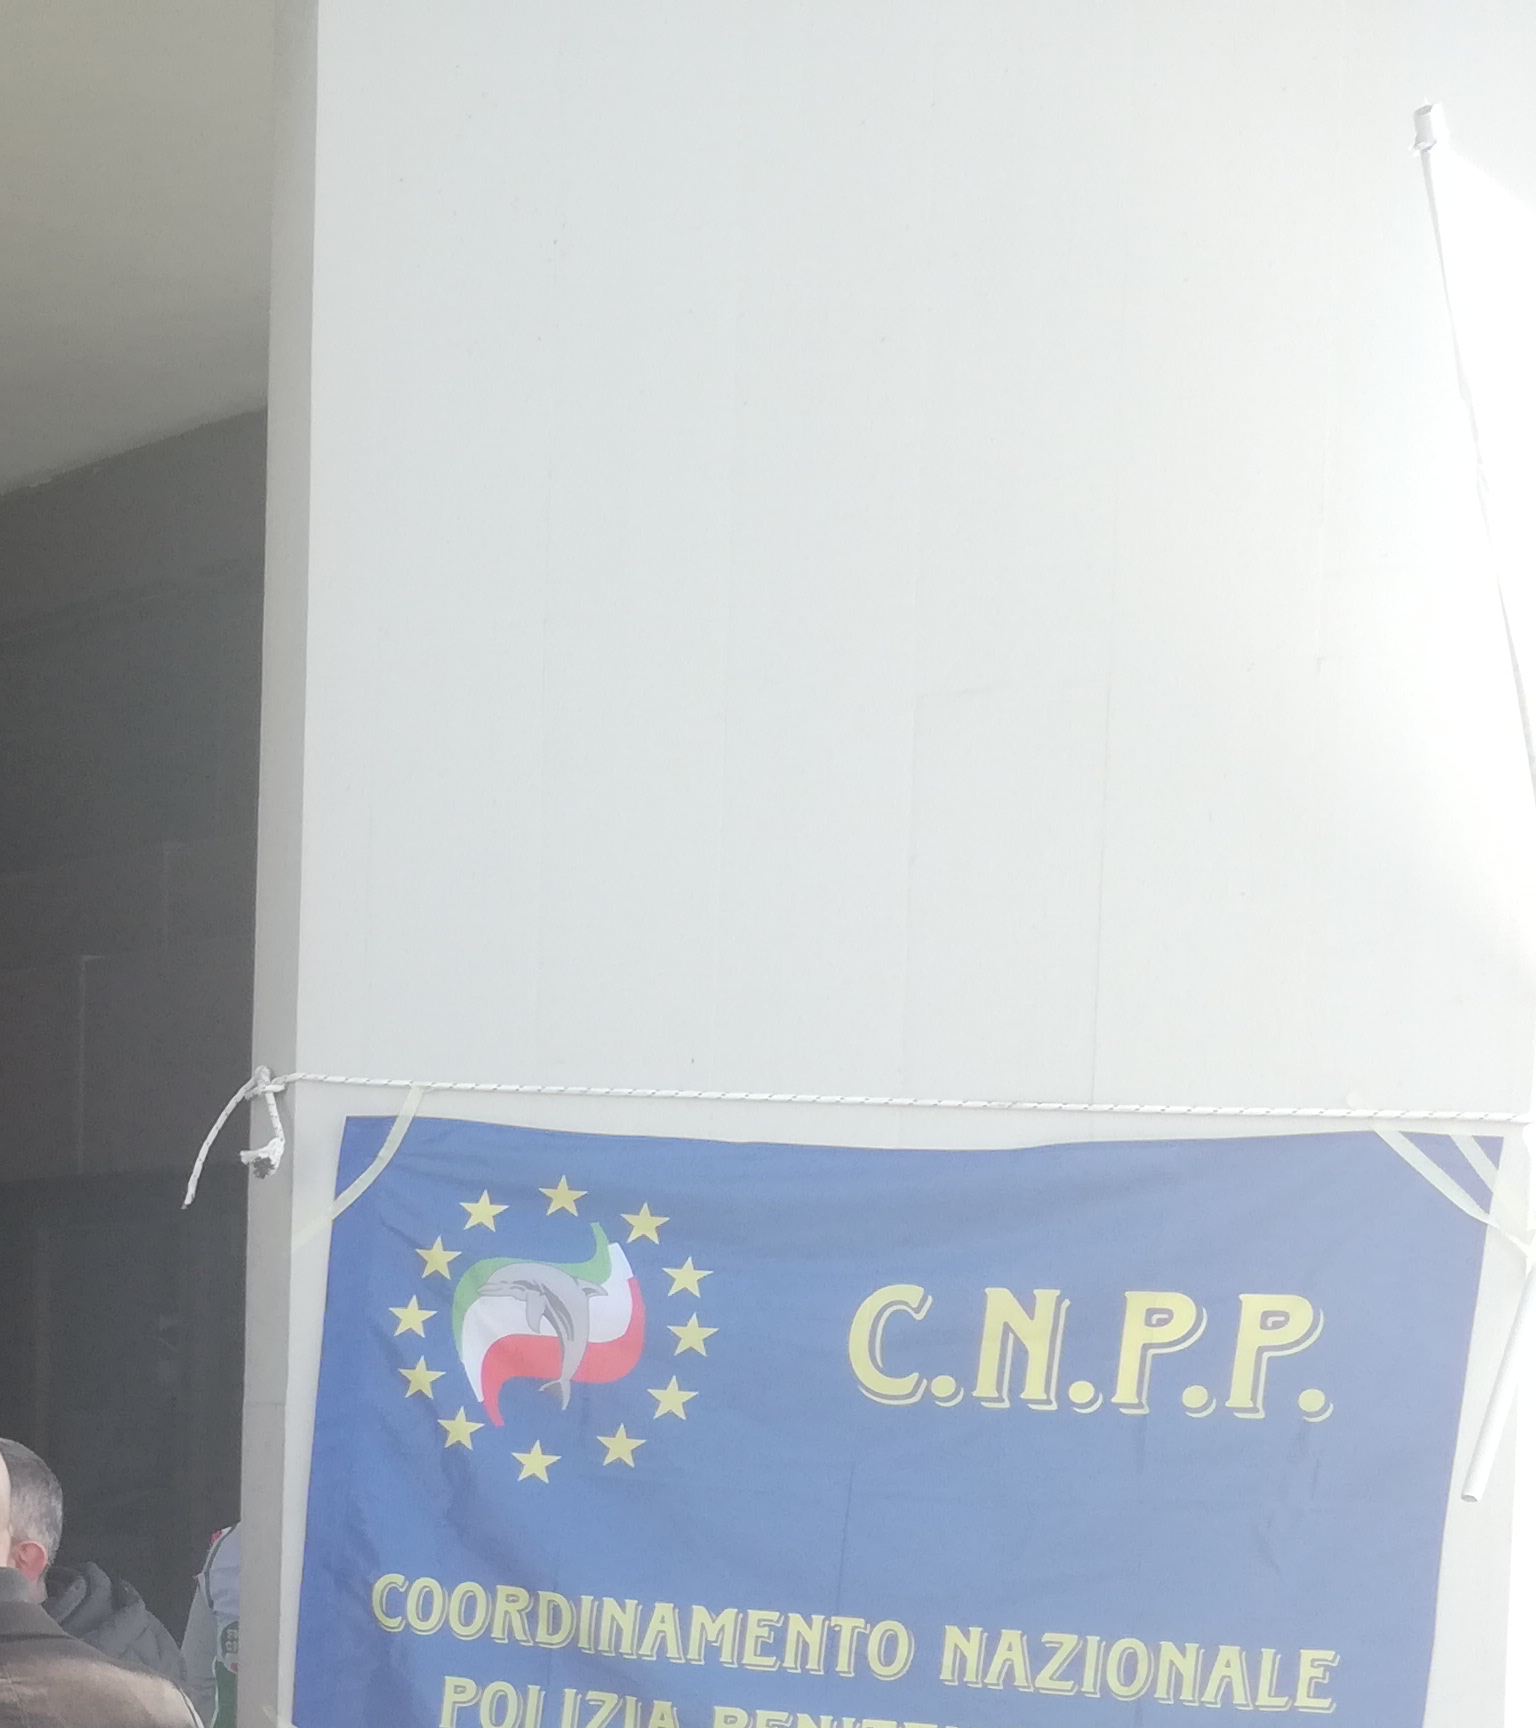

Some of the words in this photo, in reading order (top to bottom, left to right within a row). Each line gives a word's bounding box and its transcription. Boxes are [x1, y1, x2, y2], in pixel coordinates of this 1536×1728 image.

[847, 1284, 1335, 1424] C.N.P.P.
[370, 1572, 916, 1684] COORDINAMENTO
[938, 1625, 1340, 1713] NAZIONALE
